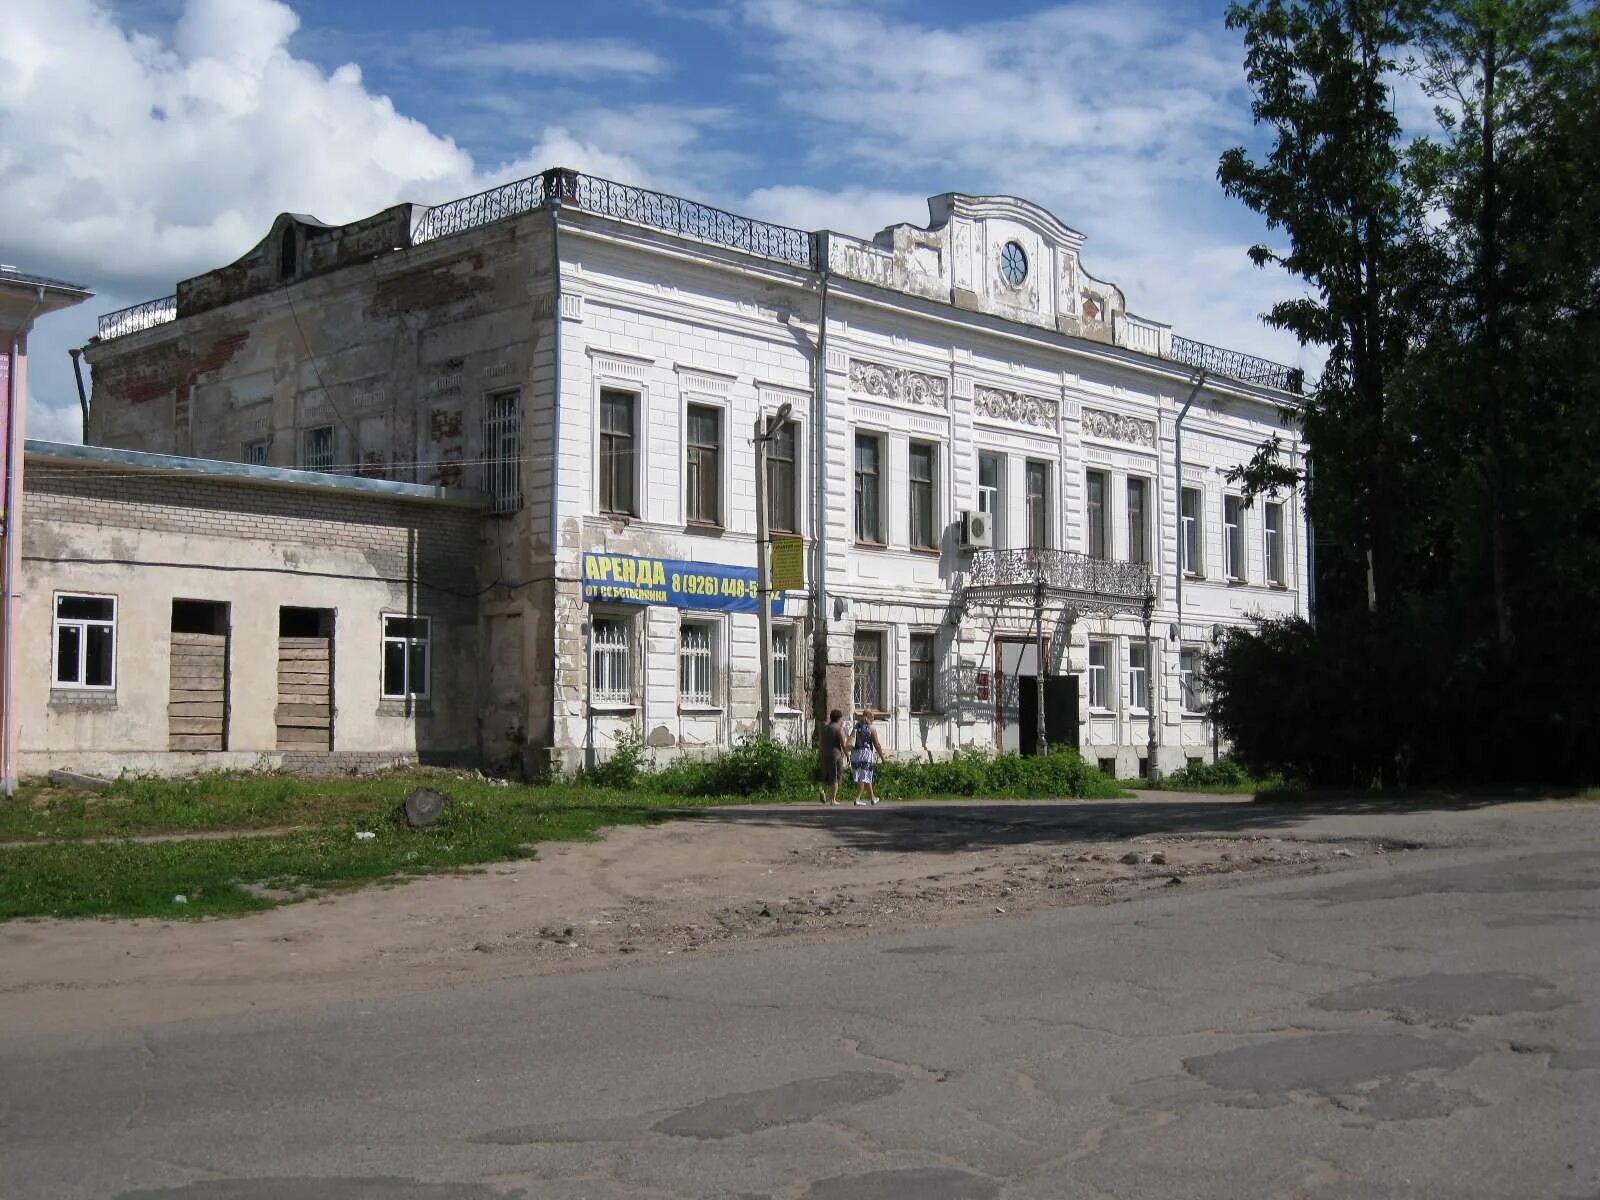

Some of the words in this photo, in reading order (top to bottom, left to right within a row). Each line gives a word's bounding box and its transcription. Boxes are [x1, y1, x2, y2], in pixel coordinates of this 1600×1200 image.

[585, 555, 666, 588] АРЕНДА
[585, 585, 598, 597] ОТ
[600, 585, 667, 602] СОБСТВЕННИКА
[671, 573, 681, 593] 8
[683, 574, 718, 596] (926)
